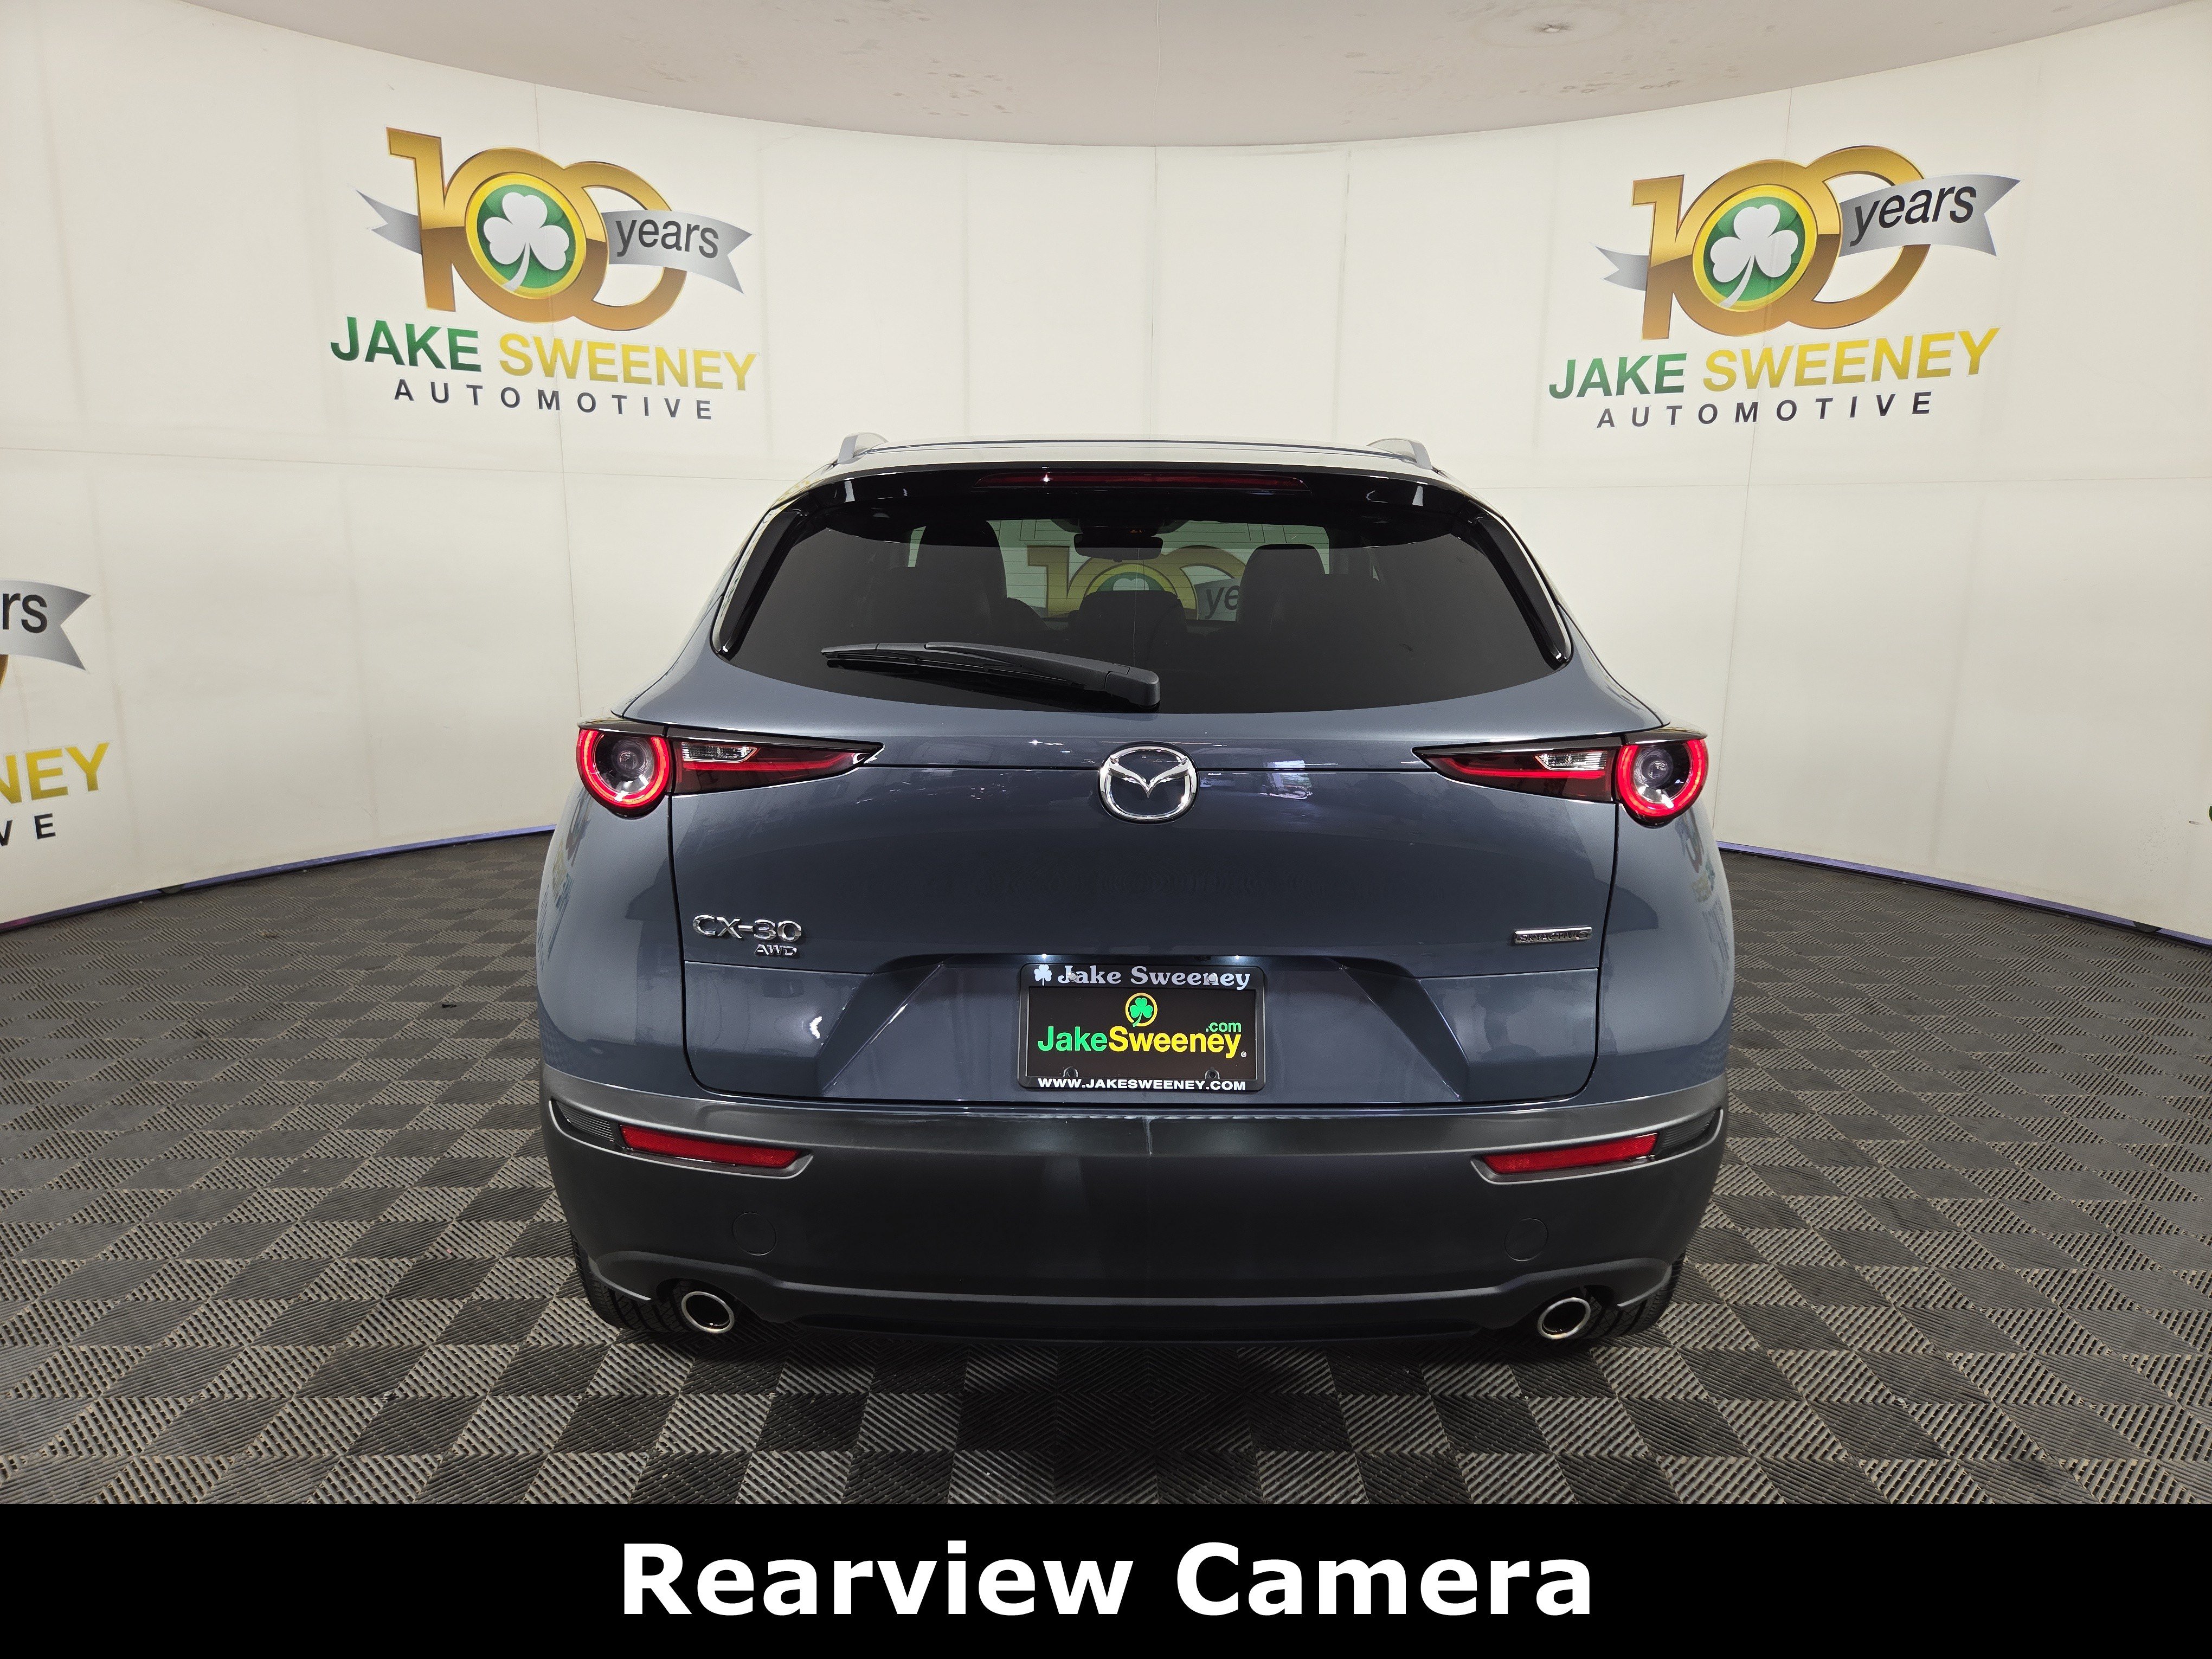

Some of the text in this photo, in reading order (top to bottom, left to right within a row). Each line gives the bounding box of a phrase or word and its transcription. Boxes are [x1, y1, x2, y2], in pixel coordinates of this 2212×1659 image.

[1850, 185, 1977, 247] years
[616, 218, 719, 259] years
[330, 316, 757, 391] JAKE SWEENEY
[1549, 327, 2001, 399] JAKE SWEENEY
[394, 379, 712, 420] AUTOMOTIVE
[1596, 391, 1933, 428] AUTOMOTIVE
[692, 914, 802, 942] CX-30
[754, 943, 798, 956] AWD
[1057, 965, 1251, 990] Jake Sweeney
[1205, 1021, 1242, 1032] .com
[1038, 1078, 1246, 1090] WWW.JAKESWEENEY.COM
